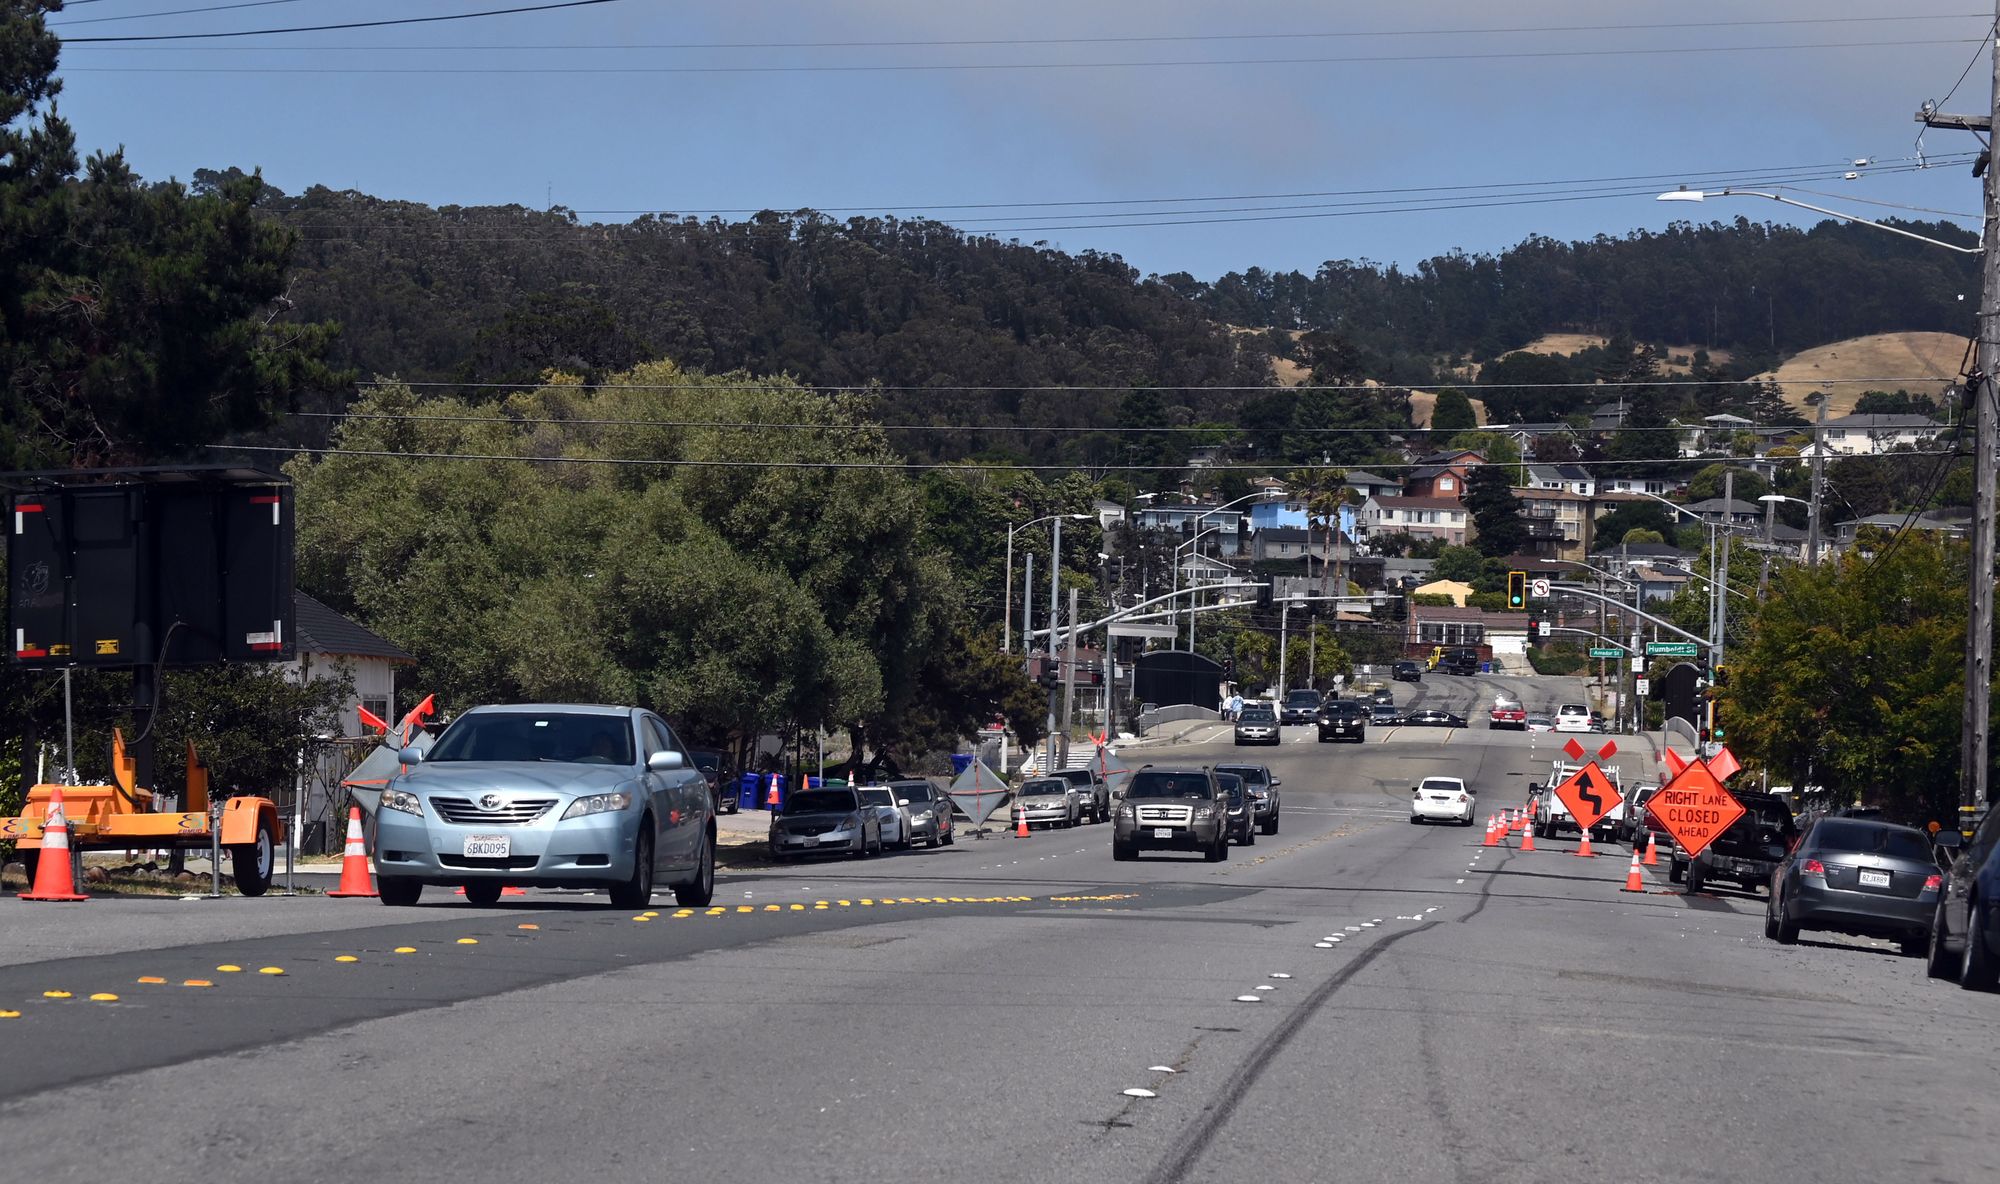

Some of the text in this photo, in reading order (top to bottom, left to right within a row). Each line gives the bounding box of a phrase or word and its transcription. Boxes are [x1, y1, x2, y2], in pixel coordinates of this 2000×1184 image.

[1648, 644, 1695, 654] Humboldt St
[1664, 791, 1728, 806] RIGHT LANE
[1669, 808, 1720, 824] CLOSED
[1677, 826, 1709, 838] AHEAD
[467, 843, 506, 854] 6BKD095
